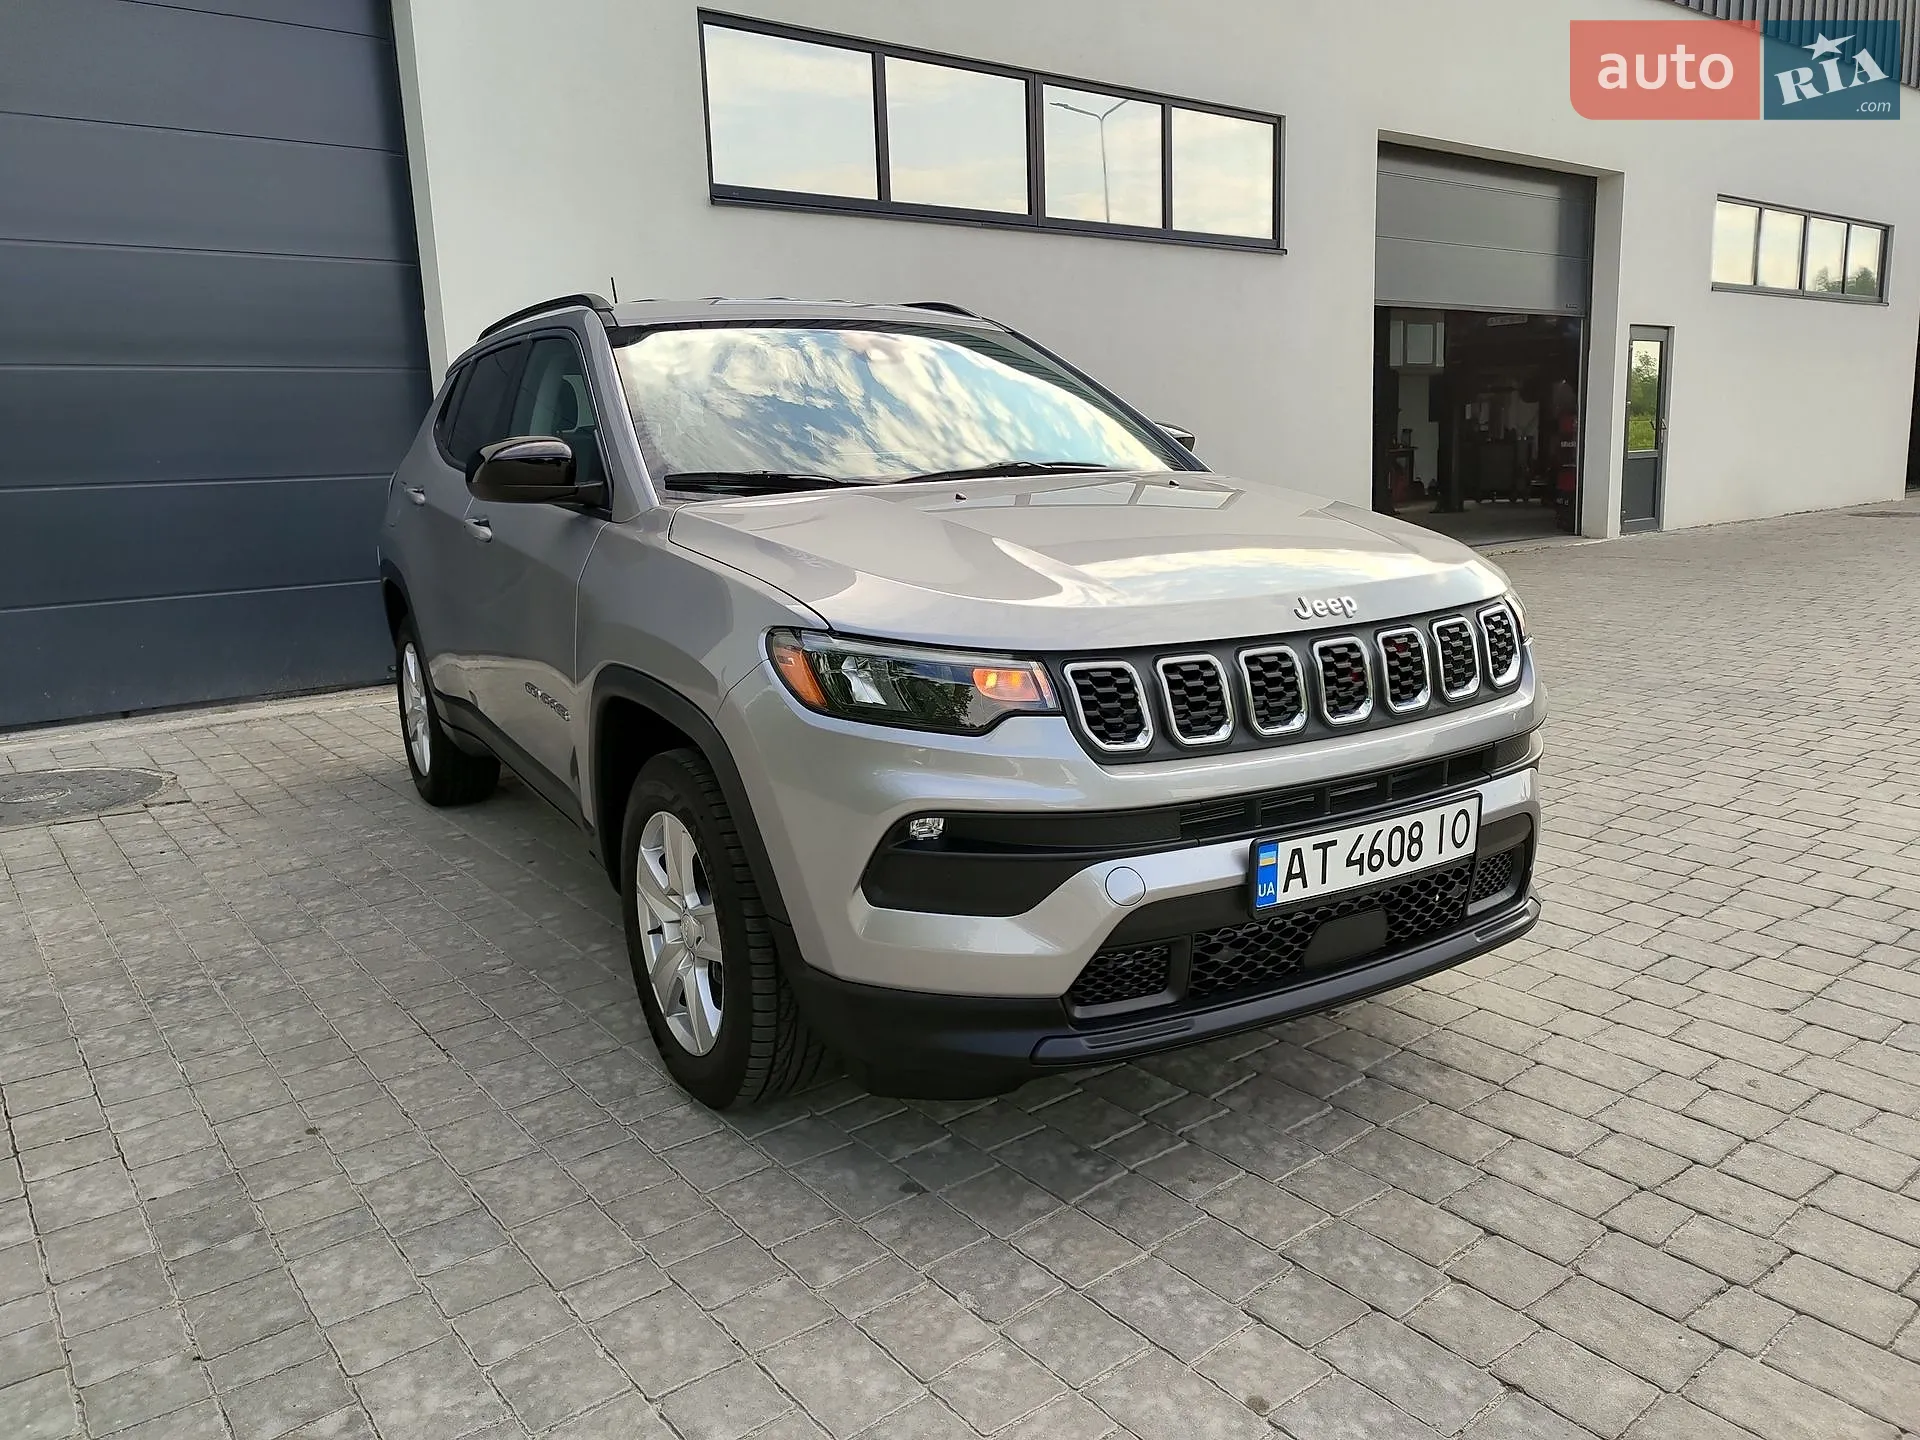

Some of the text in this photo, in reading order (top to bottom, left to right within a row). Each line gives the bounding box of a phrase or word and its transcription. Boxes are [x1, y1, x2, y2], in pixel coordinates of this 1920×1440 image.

[1294, 596, 1357, 620] Jeep
[1282, 808, 1471, 893] AT 4608 IO
[1258, 883, 1276, 897] UA
